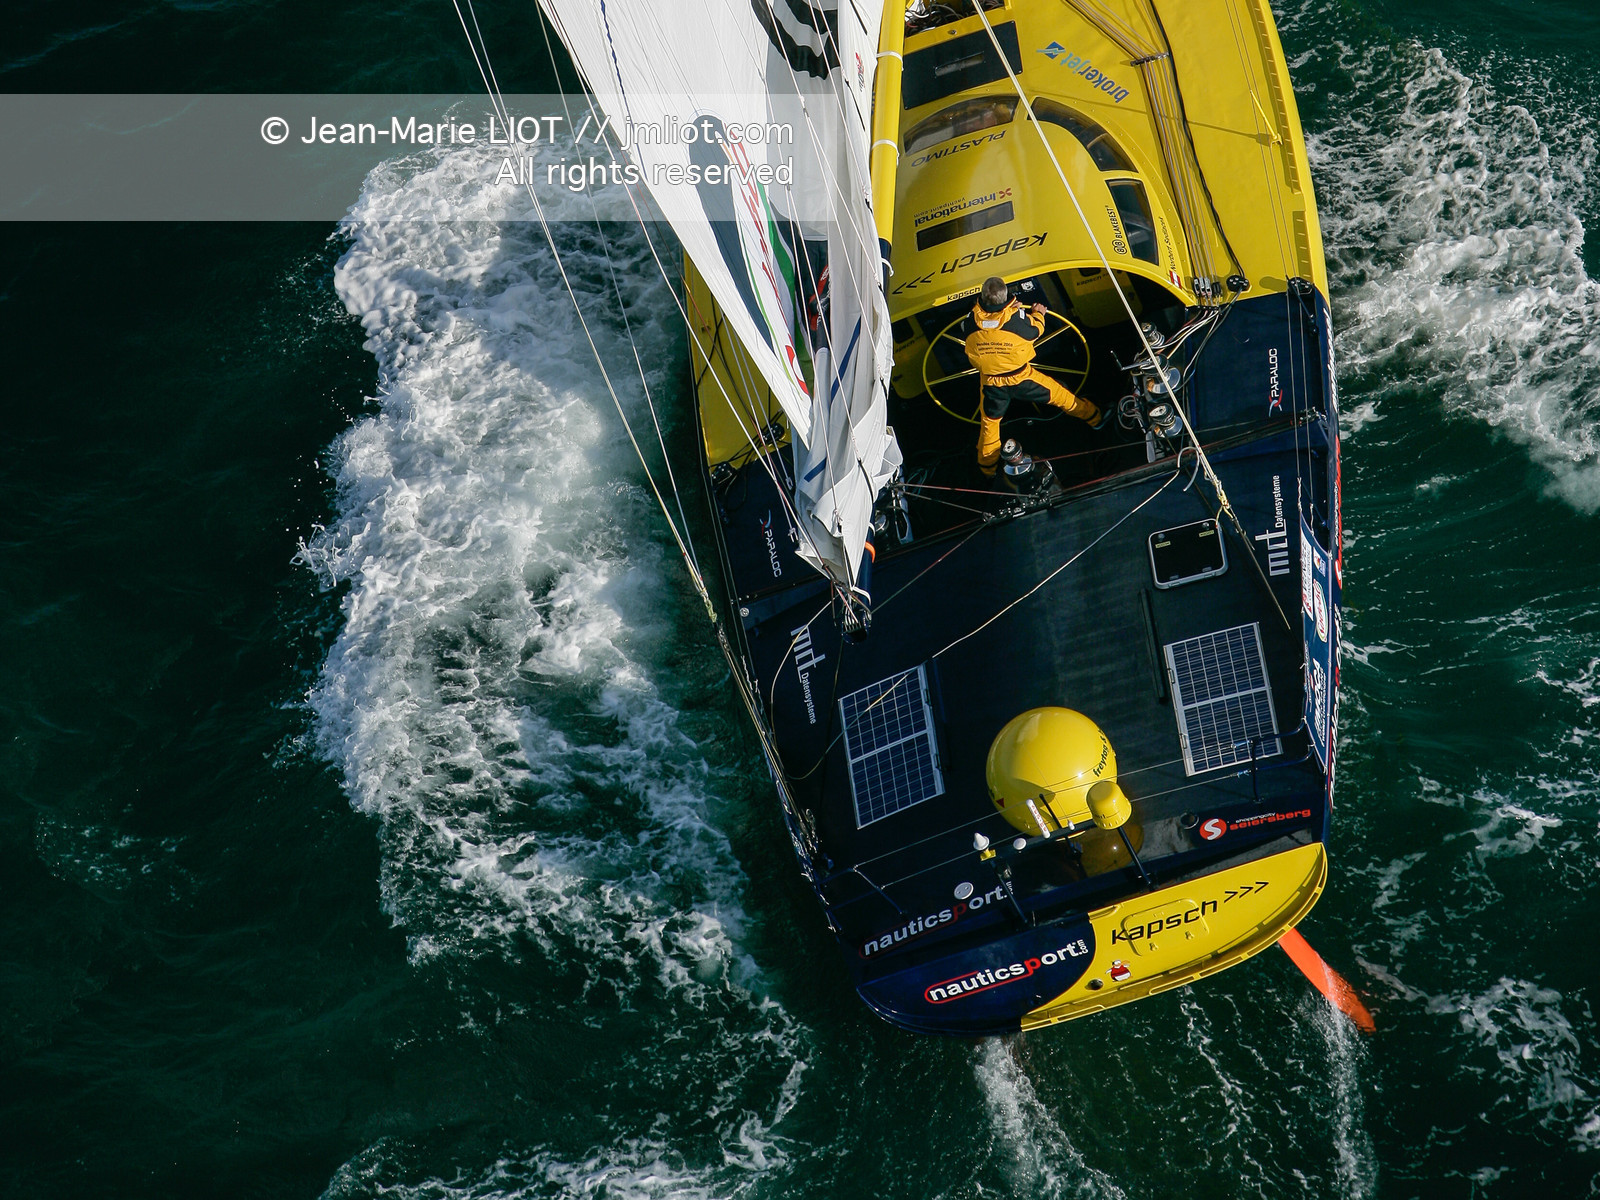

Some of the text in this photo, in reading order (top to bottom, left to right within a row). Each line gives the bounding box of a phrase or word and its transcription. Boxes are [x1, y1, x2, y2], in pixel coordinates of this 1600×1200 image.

[1060, 52, 1130, 103] brokerjet
[911, 130, 1007, 167] PLASTIMO
[914, 193, 997, 227] International
[940, 232, 1048, 274] kapsch
[947, 286, 981, 302] kapsch
[1268, 348, 1280, 398] PARALOC
[1271, 475, 1284, 528] Datensysteme
[764, 530, 782, 578] PARALOC
[801, 672, 817, 725] Datensysteme
[1228, 808, 1311, 831] seiersberg
[1236, 812, 1276, 824] shoppingcity
[1111, 900, 1218, 944] kapsch
